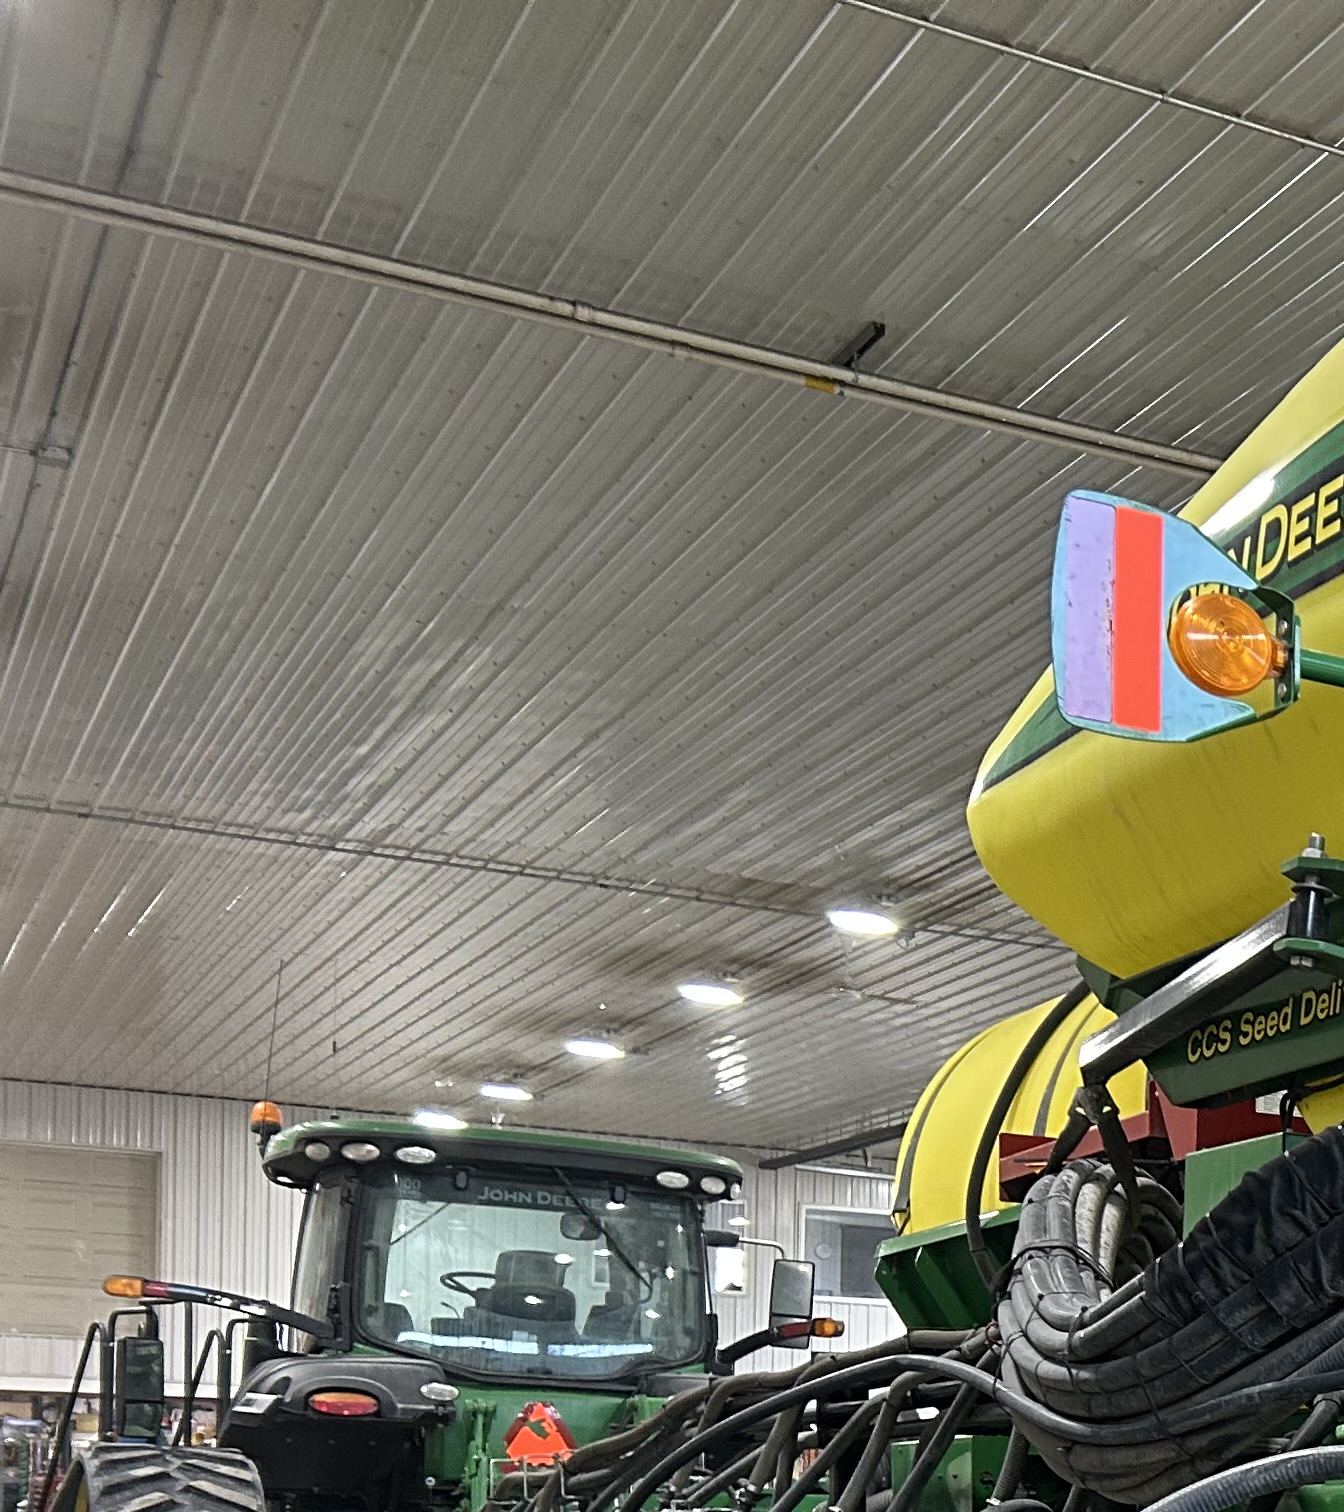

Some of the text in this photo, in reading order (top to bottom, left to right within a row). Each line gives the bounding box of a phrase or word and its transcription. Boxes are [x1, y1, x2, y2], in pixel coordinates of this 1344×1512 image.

[1186, 1020, 1232, 1064] CCS
[1238, 997, 1293, 1047] Seed
[477, 1186, 533, 1204] JOHN
